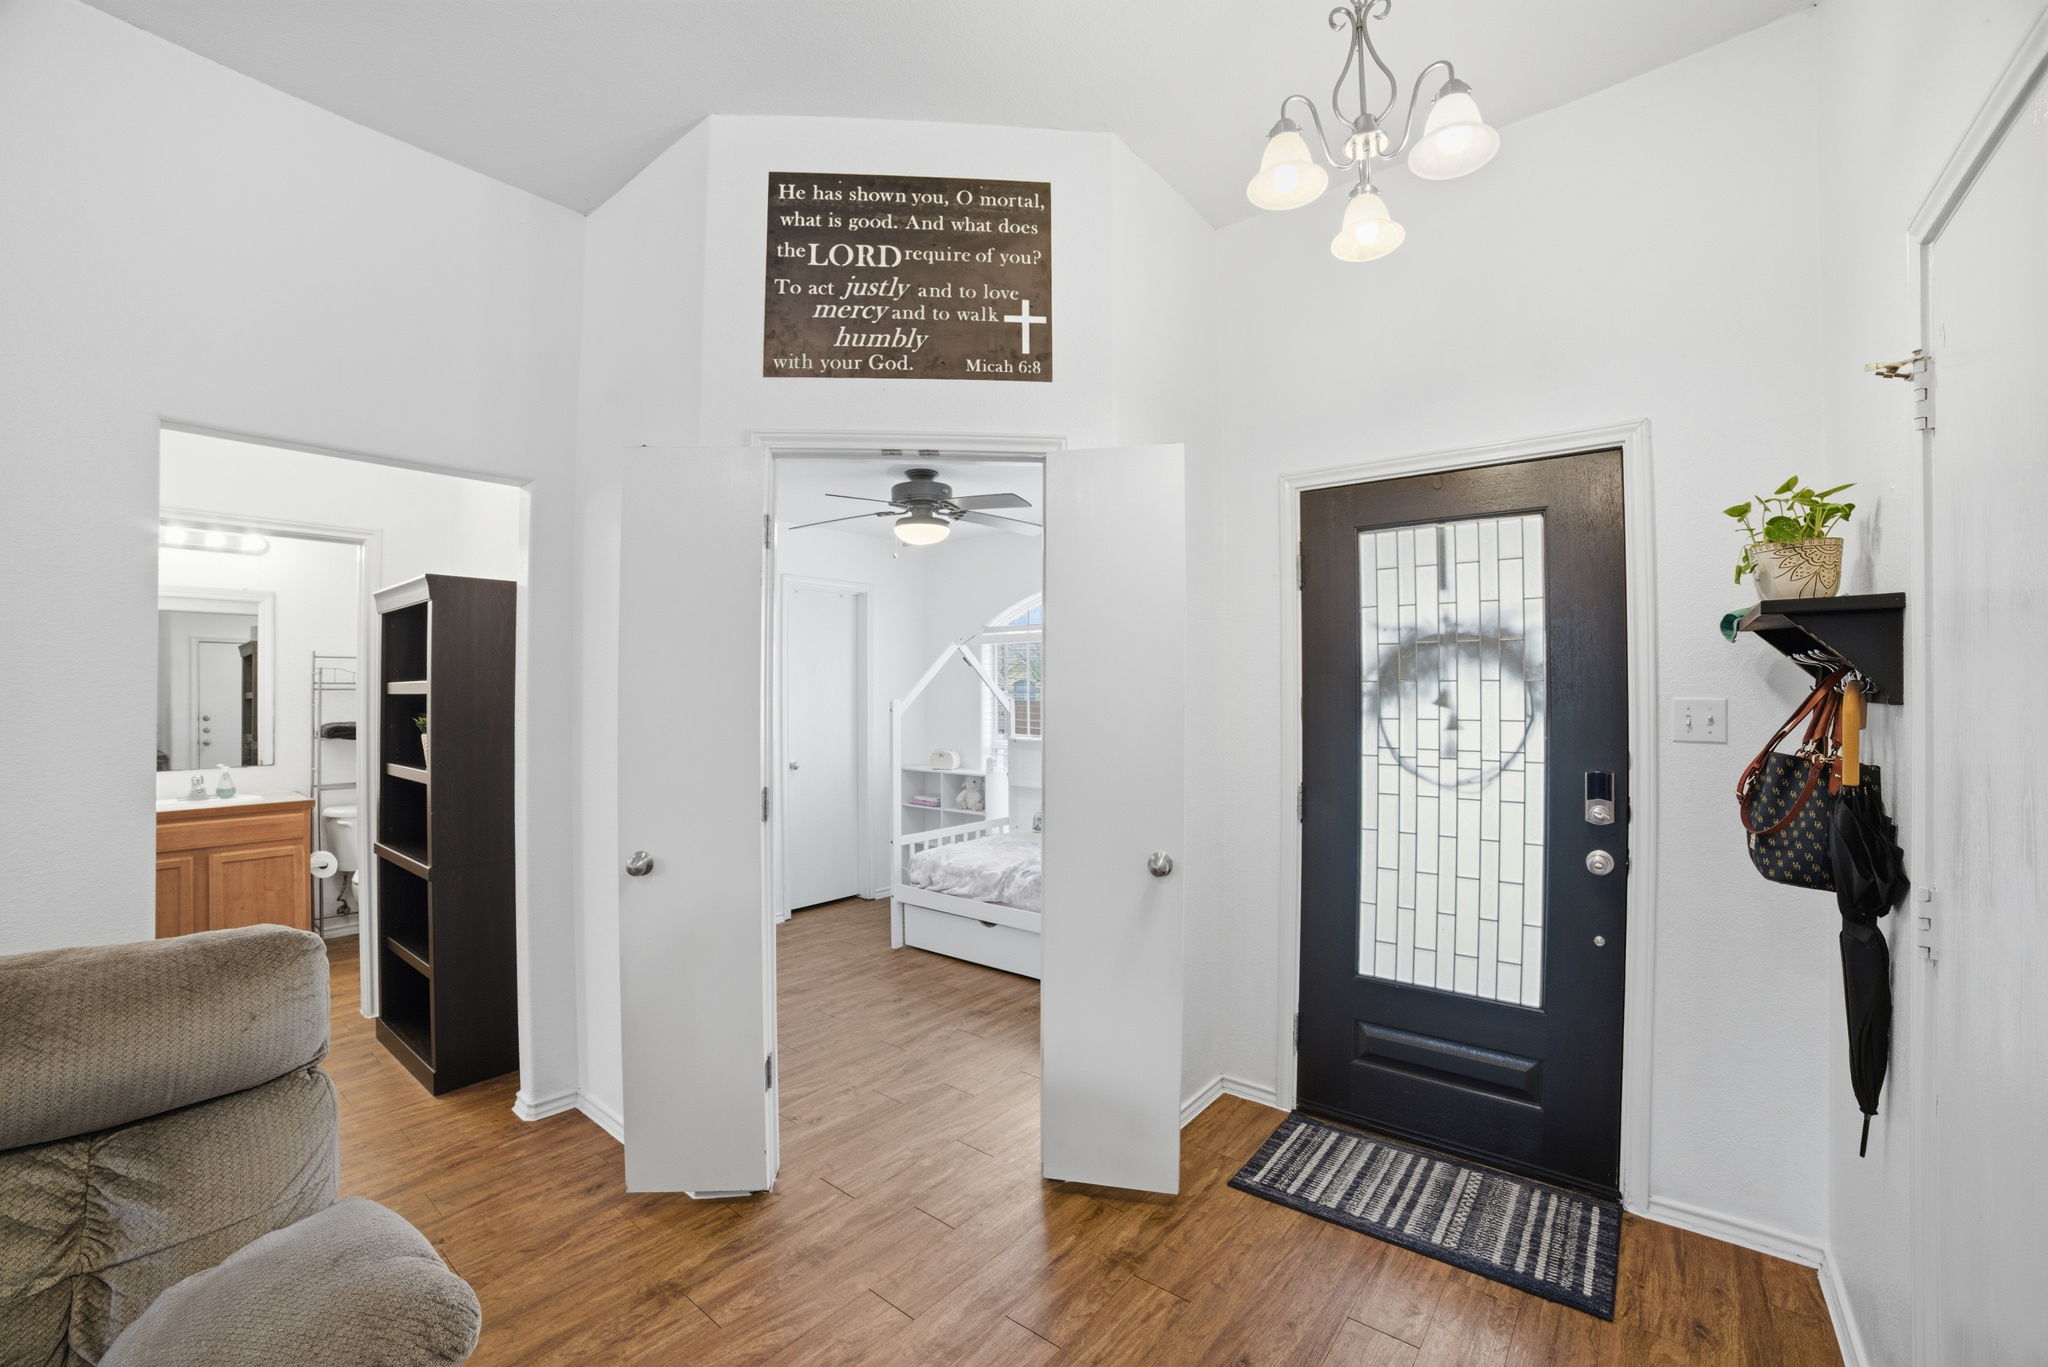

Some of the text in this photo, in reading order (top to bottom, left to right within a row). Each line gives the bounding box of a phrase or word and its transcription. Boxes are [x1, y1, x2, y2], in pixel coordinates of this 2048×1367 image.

[778, 183, 1045, 212] He has shown you, O mortal,
[780, 210, 1039, 235] what is good. And what does
[777, 241, 1042, 268] the LORD require of you?
[774, 275, 1020, 302] To act justly and to love
[811, 304, 1000, 324] mercy and to walk
[832, 325, 929, 353] humbly
[772, 352, 914, 373] with your God.
[965, 358, 1041, 374] Micah 6:8
